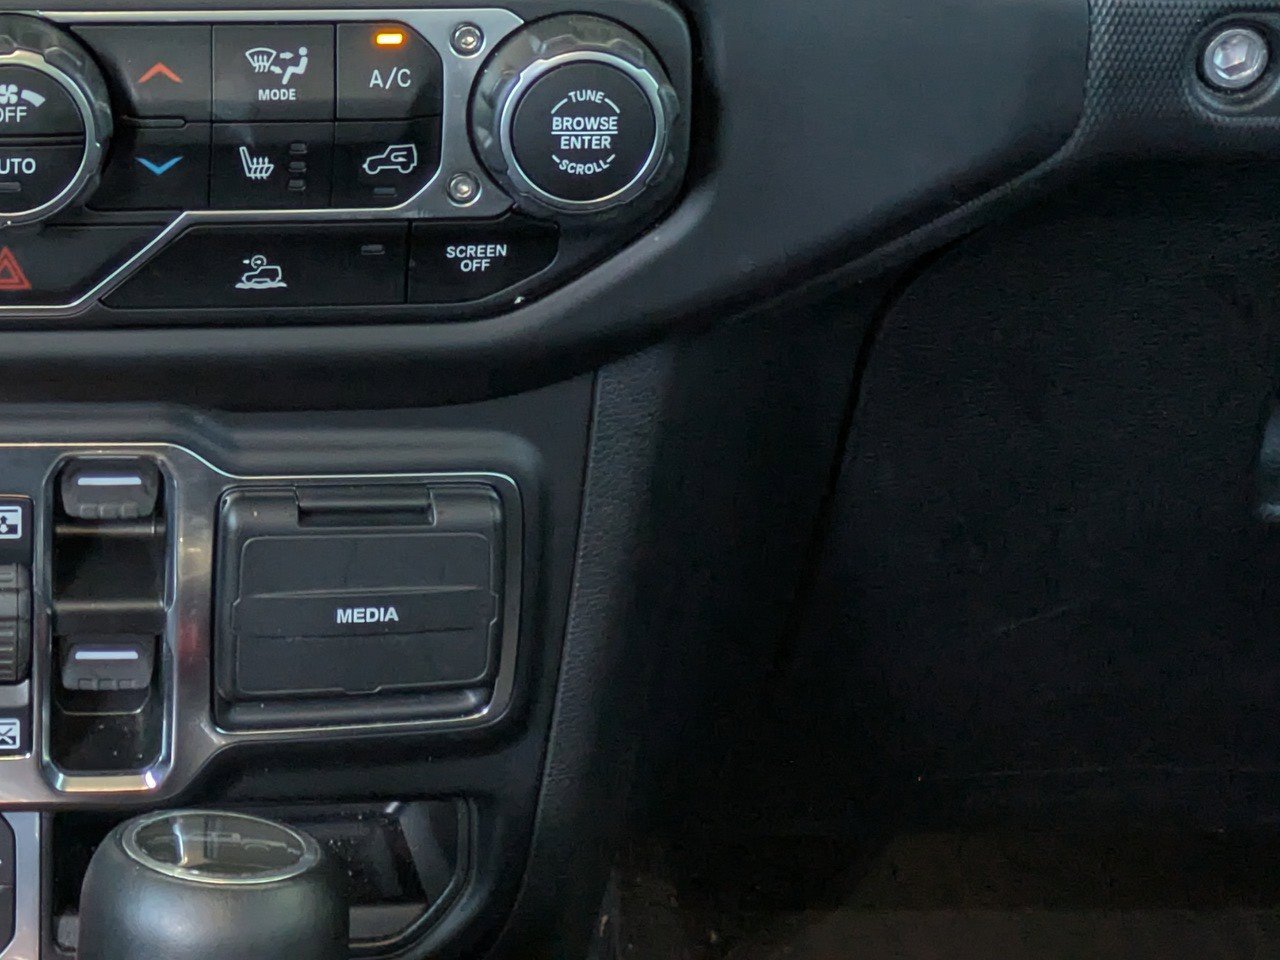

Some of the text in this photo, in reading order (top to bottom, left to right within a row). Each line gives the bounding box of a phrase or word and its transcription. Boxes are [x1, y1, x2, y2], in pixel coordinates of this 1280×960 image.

[369, 67, 412, 90] A/C
[258, 88, 297, 101] MODE
[568, 90, 604, 104] TUNE
[552, 116, 618, 130] BROWSE
[560, 136, 611, 149] ENTER
[559, 159, 610, 175] SCROLL
[446, 244, 507, 259] SCREEN
[460, 258, 491, 272] OFF
[336, 607, 399, 624] MEDIA
